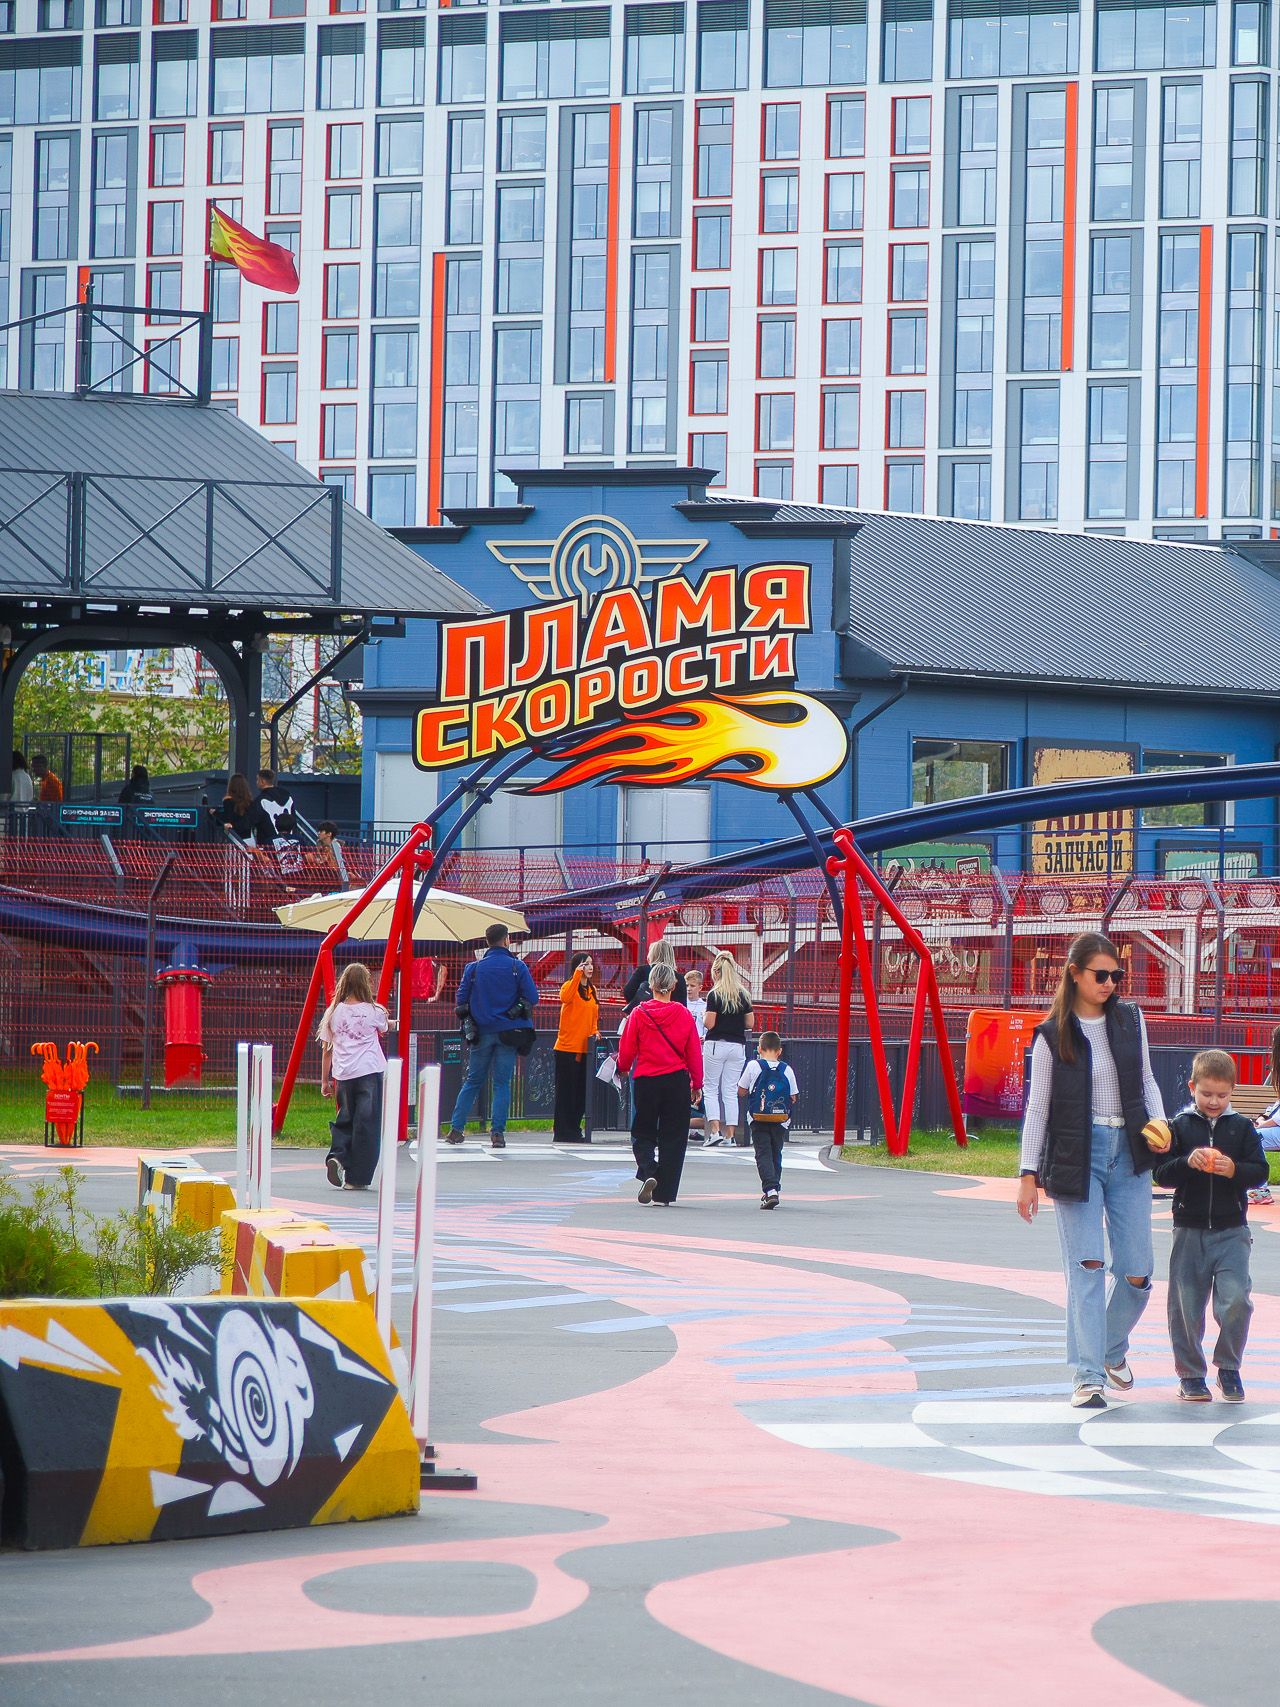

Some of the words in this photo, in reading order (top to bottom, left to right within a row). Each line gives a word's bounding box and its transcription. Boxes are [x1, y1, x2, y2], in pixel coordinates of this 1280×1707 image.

[440, 562, 811, 702] ПЛАМЯ
[417, 633, 796, 768] СКОРОСТИ
[1044, 839, 1123, 874] ЗАПЧАСИ
